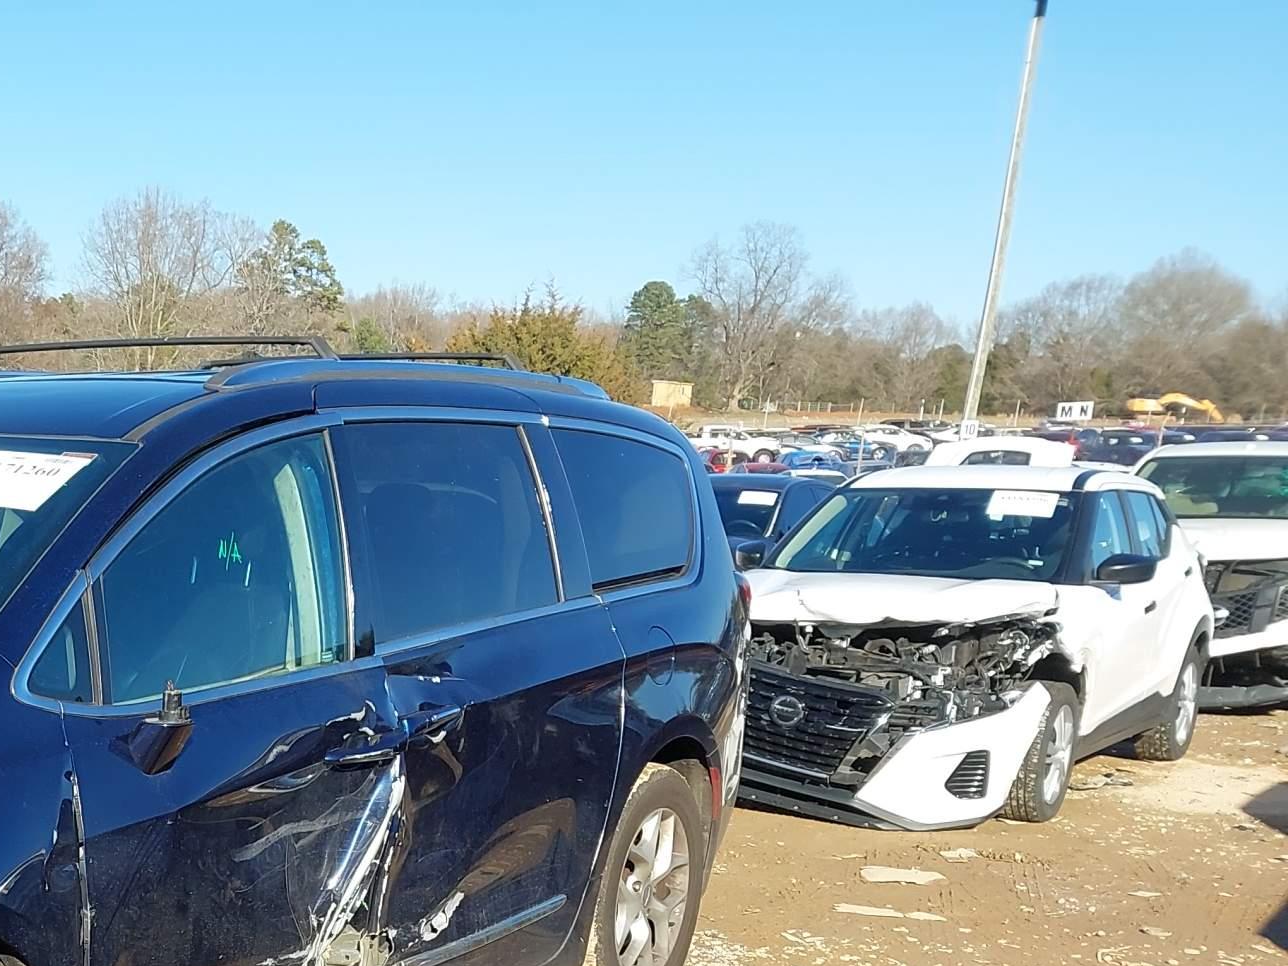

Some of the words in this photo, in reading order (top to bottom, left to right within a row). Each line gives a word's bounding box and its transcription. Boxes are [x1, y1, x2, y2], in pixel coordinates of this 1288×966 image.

[1060, 405, 1072, 418] M
[1079, 404, 1089, 417] N
[964, 424, 976, 435] 10
[218, 531, 242, 571] N/A
